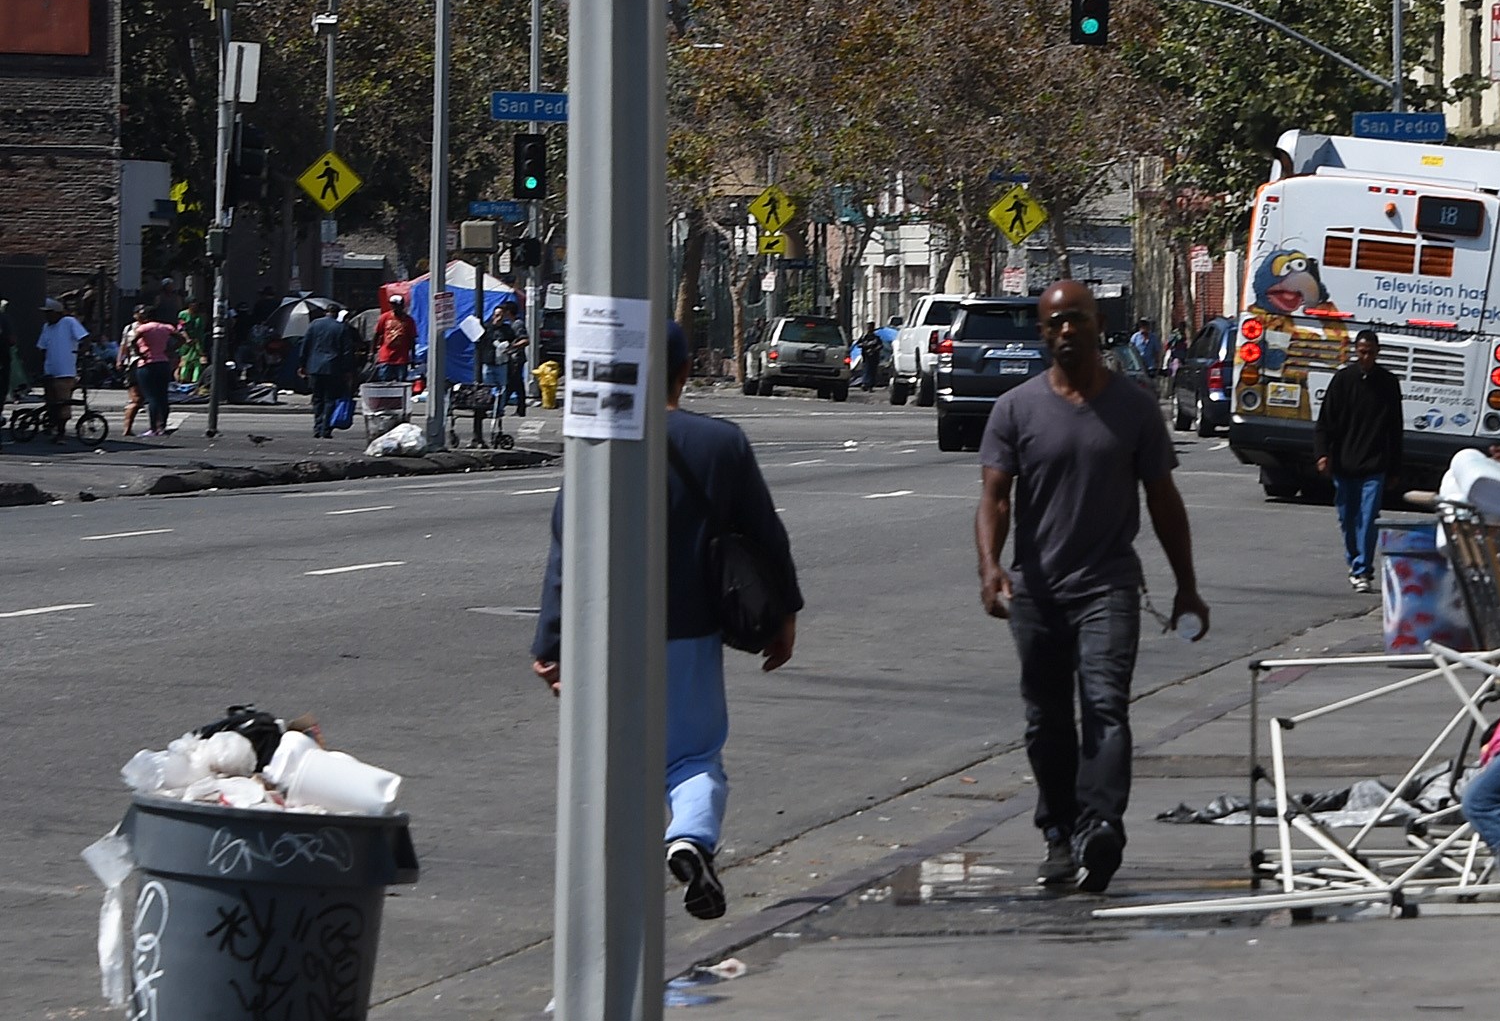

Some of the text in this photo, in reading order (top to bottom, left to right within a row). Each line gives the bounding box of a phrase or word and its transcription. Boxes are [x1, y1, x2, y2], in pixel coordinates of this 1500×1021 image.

[499, 98, 528, 113] San
[1360, 119, 1440, 134] San Pedro
[1257, 203, 1270, 251] 6077
[1375, 276, 1488, 301] Television has
[1357, 292, 1408, 315] finally
[1411, 297, 1433, 314] hit
[1437, 300, 1455, 316] its
